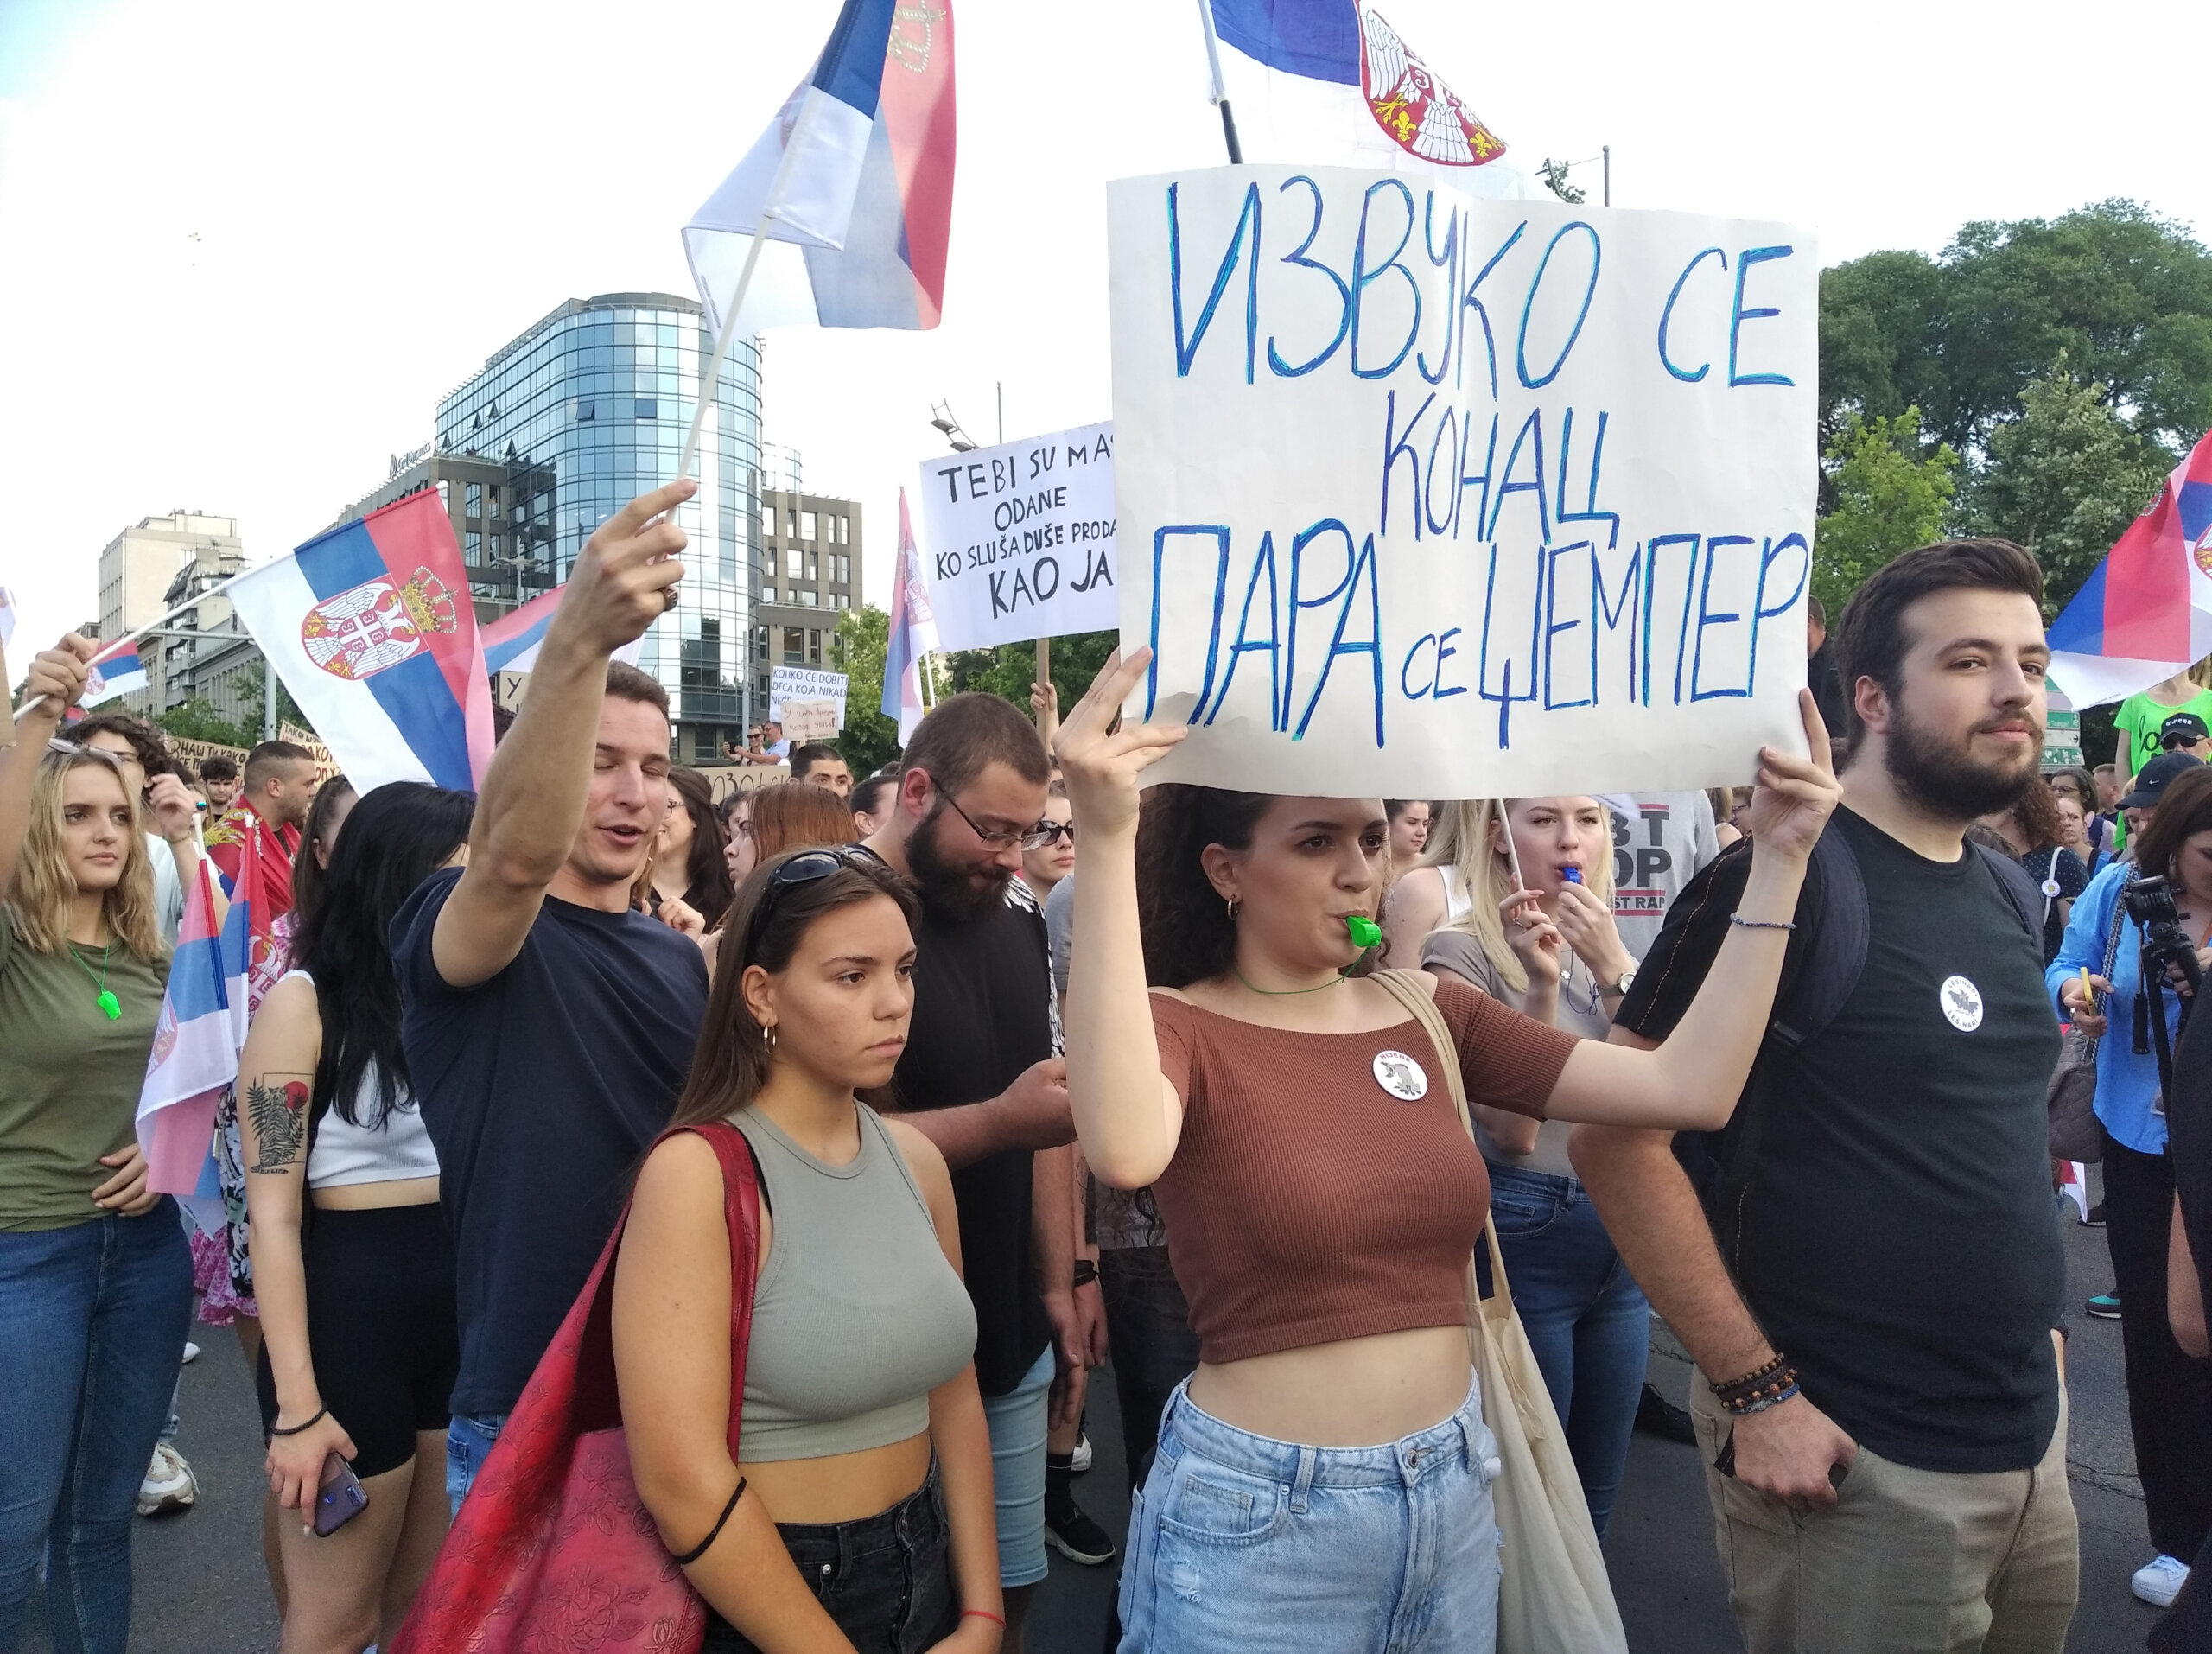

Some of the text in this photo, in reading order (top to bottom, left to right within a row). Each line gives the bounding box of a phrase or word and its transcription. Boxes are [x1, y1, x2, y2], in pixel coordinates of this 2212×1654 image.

[1167, 175, 1796, 400] ИЗВУКО СЕ
[938, 433, 1113, 504] TEBI SU MA
[1382, 390, 1620, 550] КОНАЦ
[994, 486, 1067, 531] ODANE
[936, 551, 962, 581] KO
[967, 534, 1020, 569] SLUŠA
[1024, 522, 1065, 554] DUŠE
[988, 550, 1114, 620] KAO JA
[1143, 518, 1384, 749] ПАРА
[1401, 627, 1468, 701] СЕ
[772, 682, 847, 697] DECA KOJA NIKAD
[773, 669, 848, 686] KOLIKO ĆE DOBITI
[1635, 896, 1666, 910] RAP
